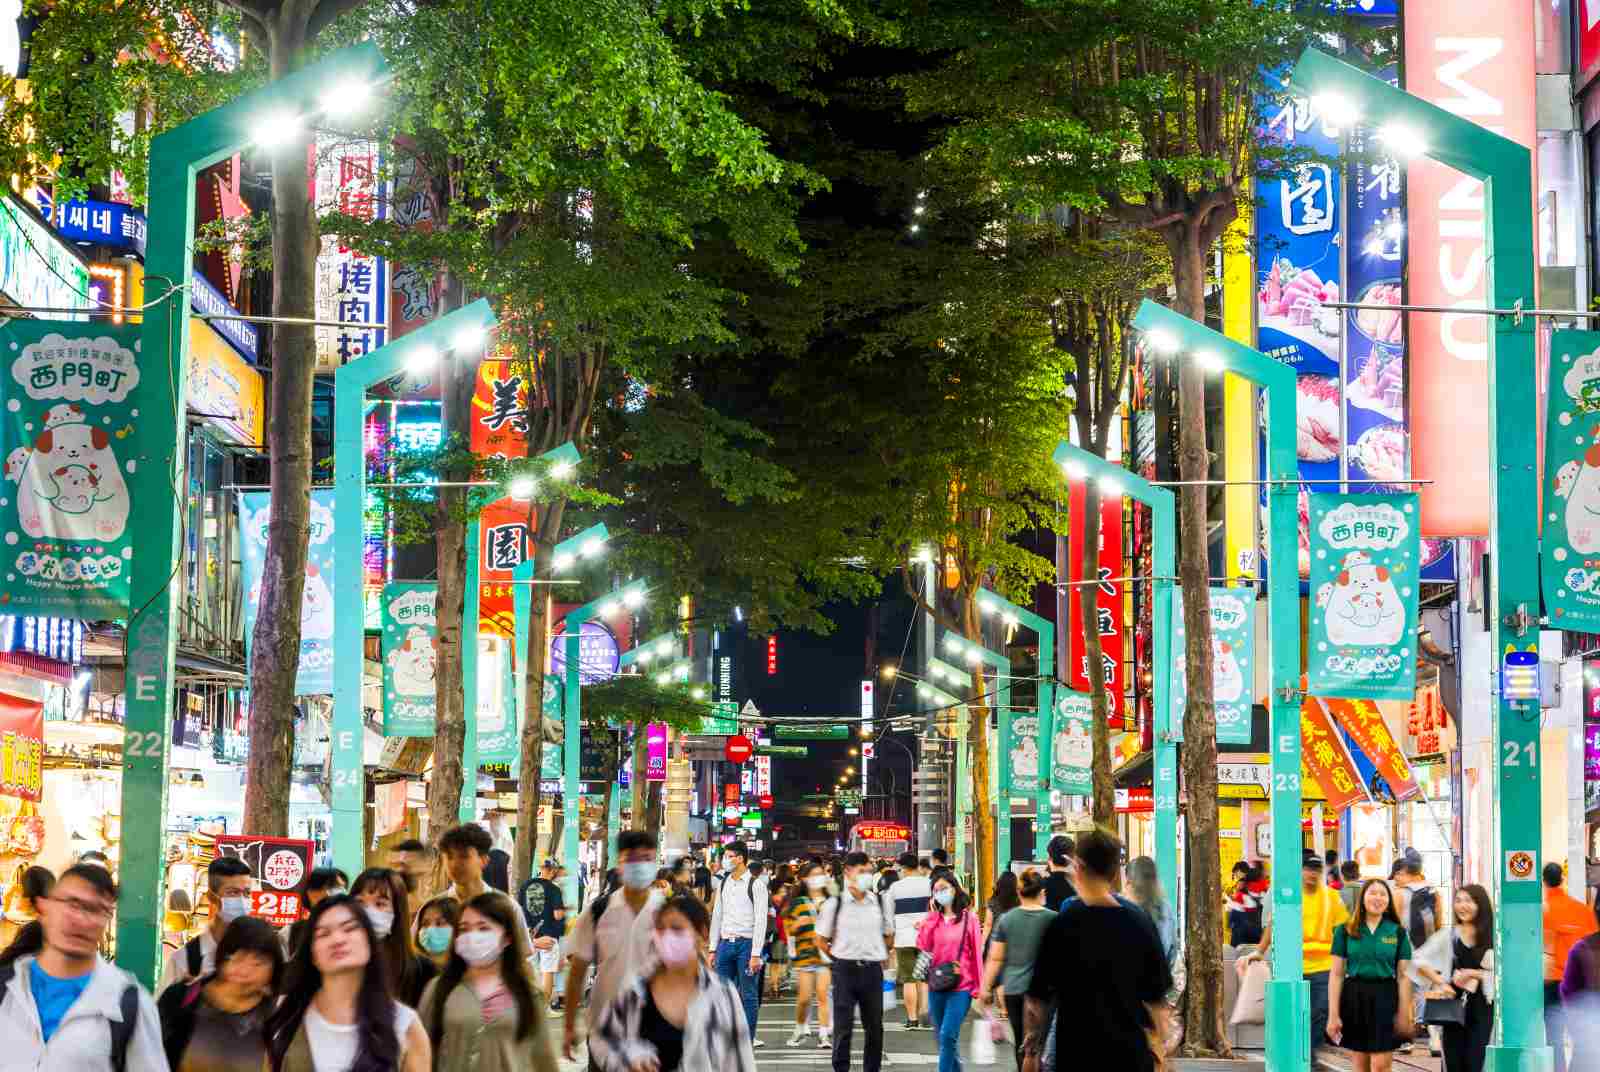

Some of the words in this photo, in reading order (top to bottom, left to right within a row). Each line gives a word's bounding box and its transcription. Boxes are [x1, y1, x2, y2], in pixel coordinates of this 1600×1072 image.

[30, 362, 127, 393] 西門町
[1332, 521, 1400, 542] 西門町
[399, 604, 438, 620] 西門
[136, 674, 157, 700] E
[720, 657, 731, 696] RUNNING
[127, 731, 161, 757] 22
[339, 731, 353, 750] E
[1279, 735, 1296, 753] E
[1503, 741, 1537, 767] 21
[335, 769, 358, 785] 24
[1275, 773, 1300, 792] 23
